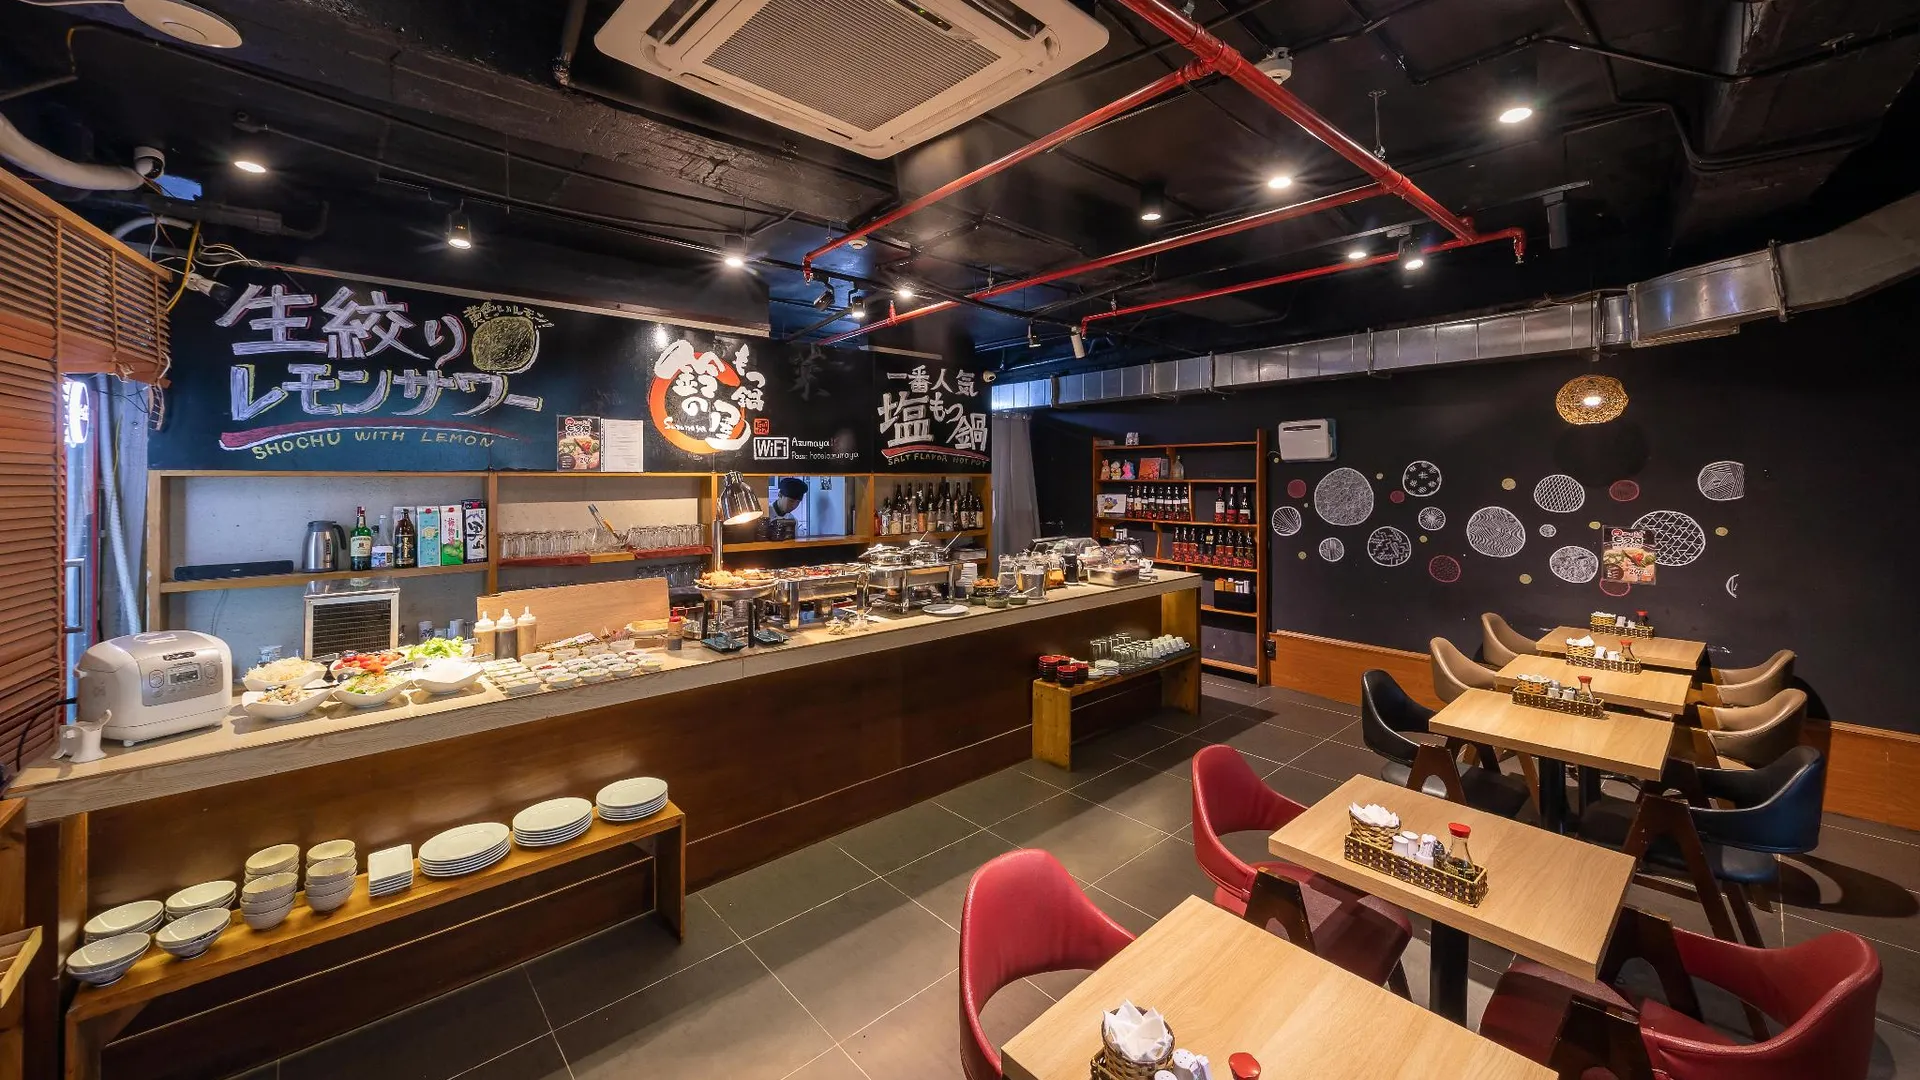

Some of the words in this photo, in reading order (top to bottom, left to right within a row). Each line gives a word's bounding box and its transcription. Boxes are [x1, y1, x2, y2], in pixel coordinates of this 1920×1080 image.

[215, 283, 467, 369] 生絞り
[230, 362, 543, 421] レモンサワー
[886, 364, 979, 397] 一番人気
[877, 391, 988, 452] 塩もつ鍋
[251, 431, 341, 460] SHOCHU
[354, 431, 405, 441] WITH
[420, 431, 495, 448] LEMON
[756, 439, 787, 457] WiFi
[887, 454, 910, 466] SALT
[913, 452, 948, 463] FLAVOR
[952, 456, 968, 464] HOT
